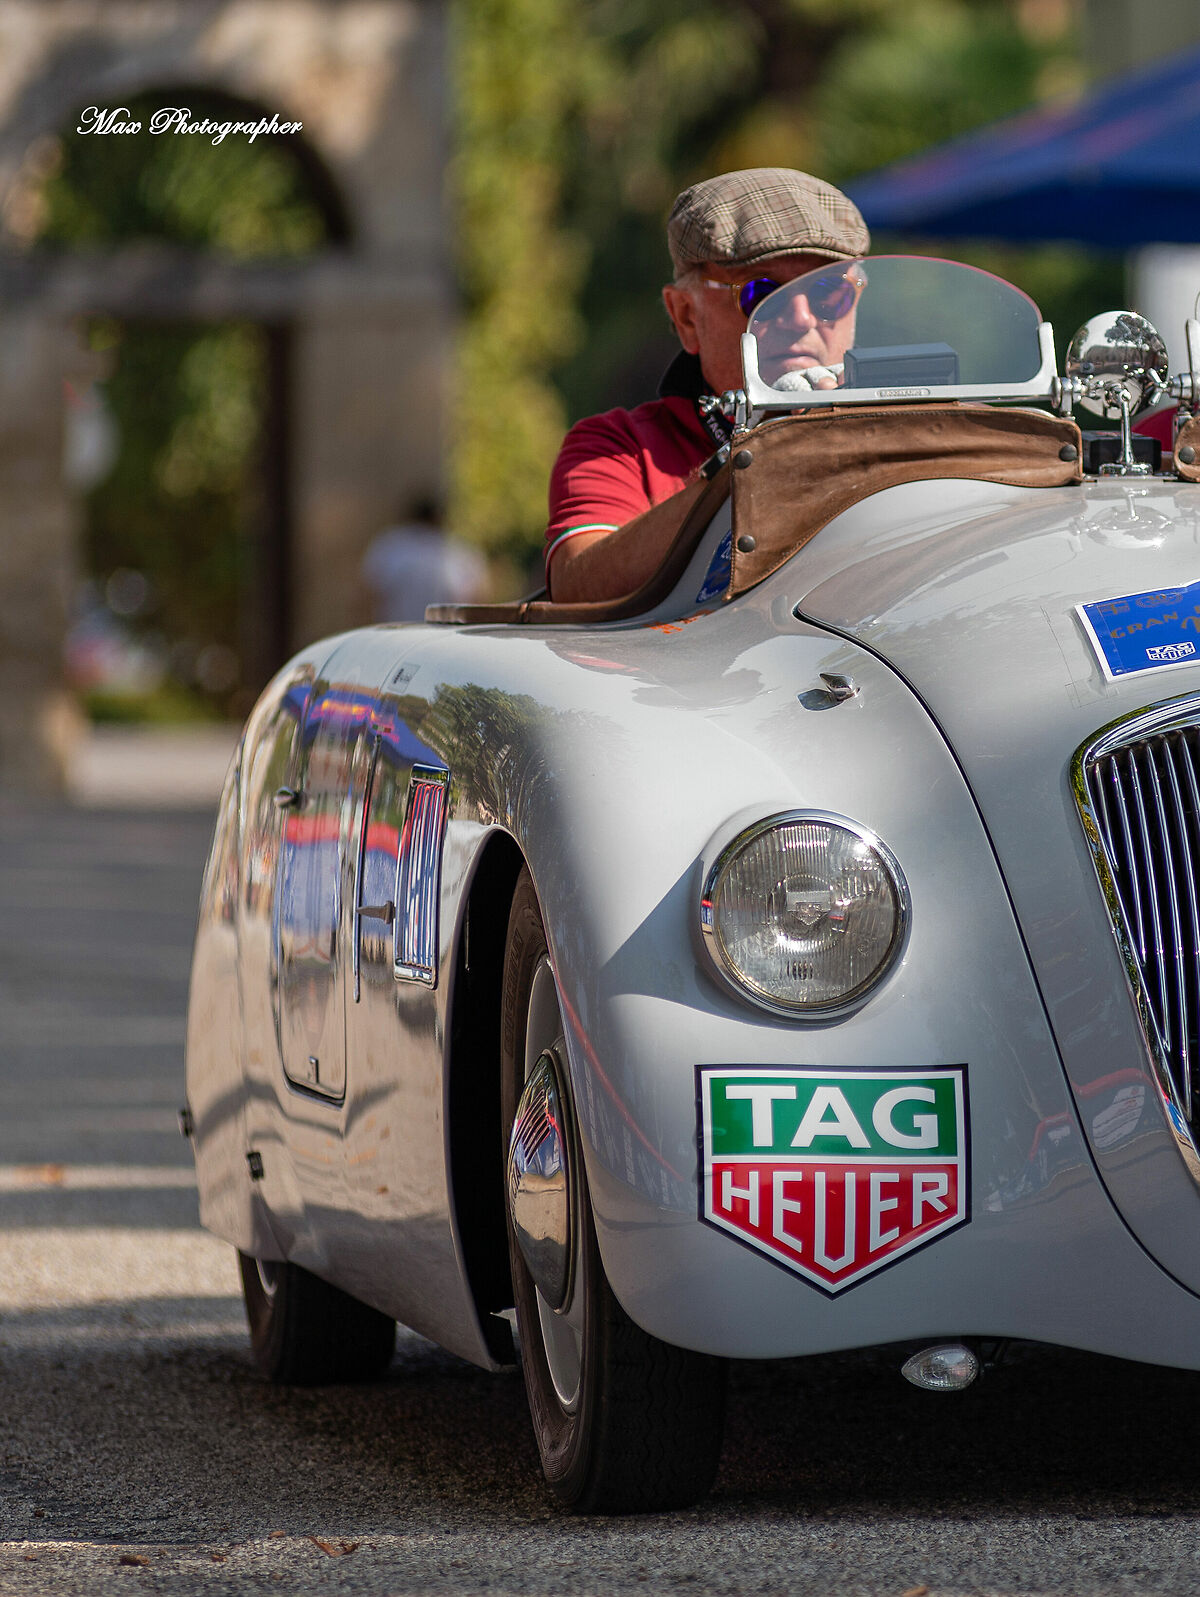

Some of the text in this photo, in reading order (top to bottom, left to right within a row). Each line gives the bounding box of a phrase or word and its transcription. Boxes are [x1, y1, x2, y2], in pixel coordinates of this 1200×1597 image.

[1110, 612, 1178, 639] GRAN
[725, 1085, 939, 1149] TAG
[721, 1171, 948, 1273] HEUER
